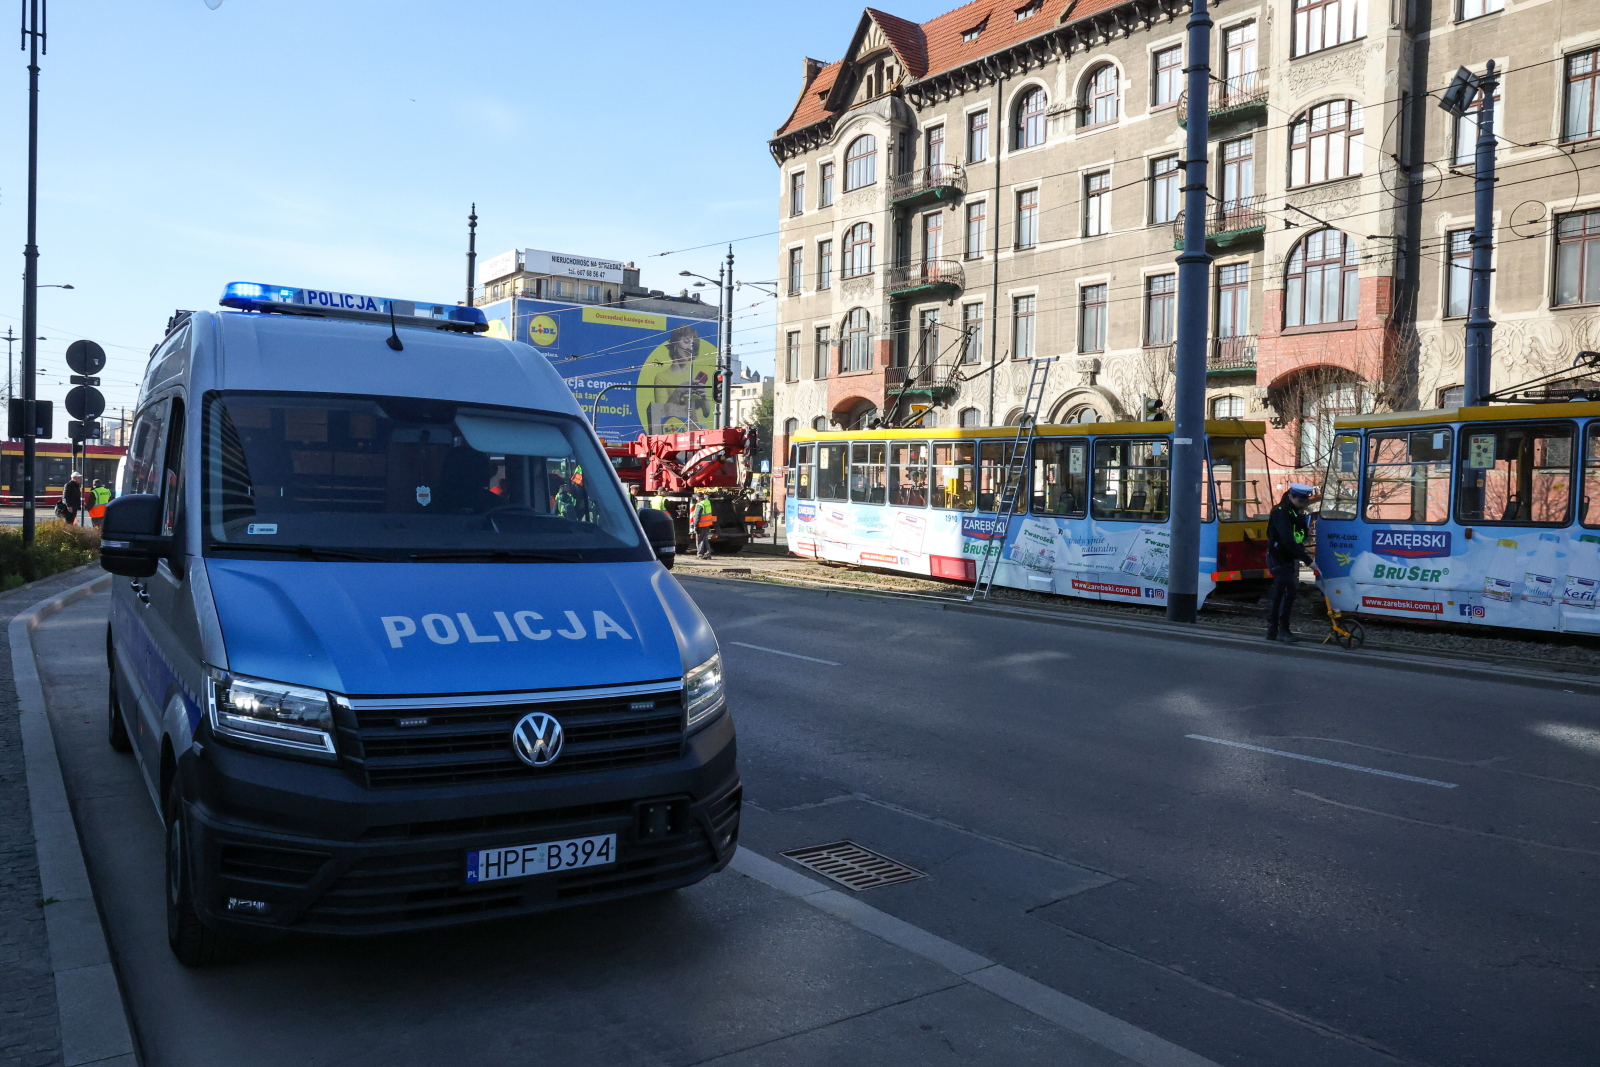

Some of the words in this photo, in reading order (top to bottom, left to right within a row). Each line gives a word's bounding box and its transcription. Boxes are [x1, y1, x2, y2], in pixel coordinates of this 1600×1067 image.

[307, 290, 378, 312] POLICJA
[587, 381, 632, 391] cenowa!
[585, 392, 608, 402] tano,
[963, 519, 1007, 533] ZARĘBSKI
[1024, 529, 1055, 545] Twarożek
[1375, 533, 1446, 549] ZARĘBSKI
[1082, 544, 1119, 554] naturalny
[1074, 581, 1138, 595] www.zarebski.com.pl
[1365, 599, 1440, 611] www.zarebski.com.pl
[381, 610, 633, 649] POLICJA
[485, 847, 538, 879] HPF
[547, 837, 611, 871] B394
[467, 870, 477, 879] PL
